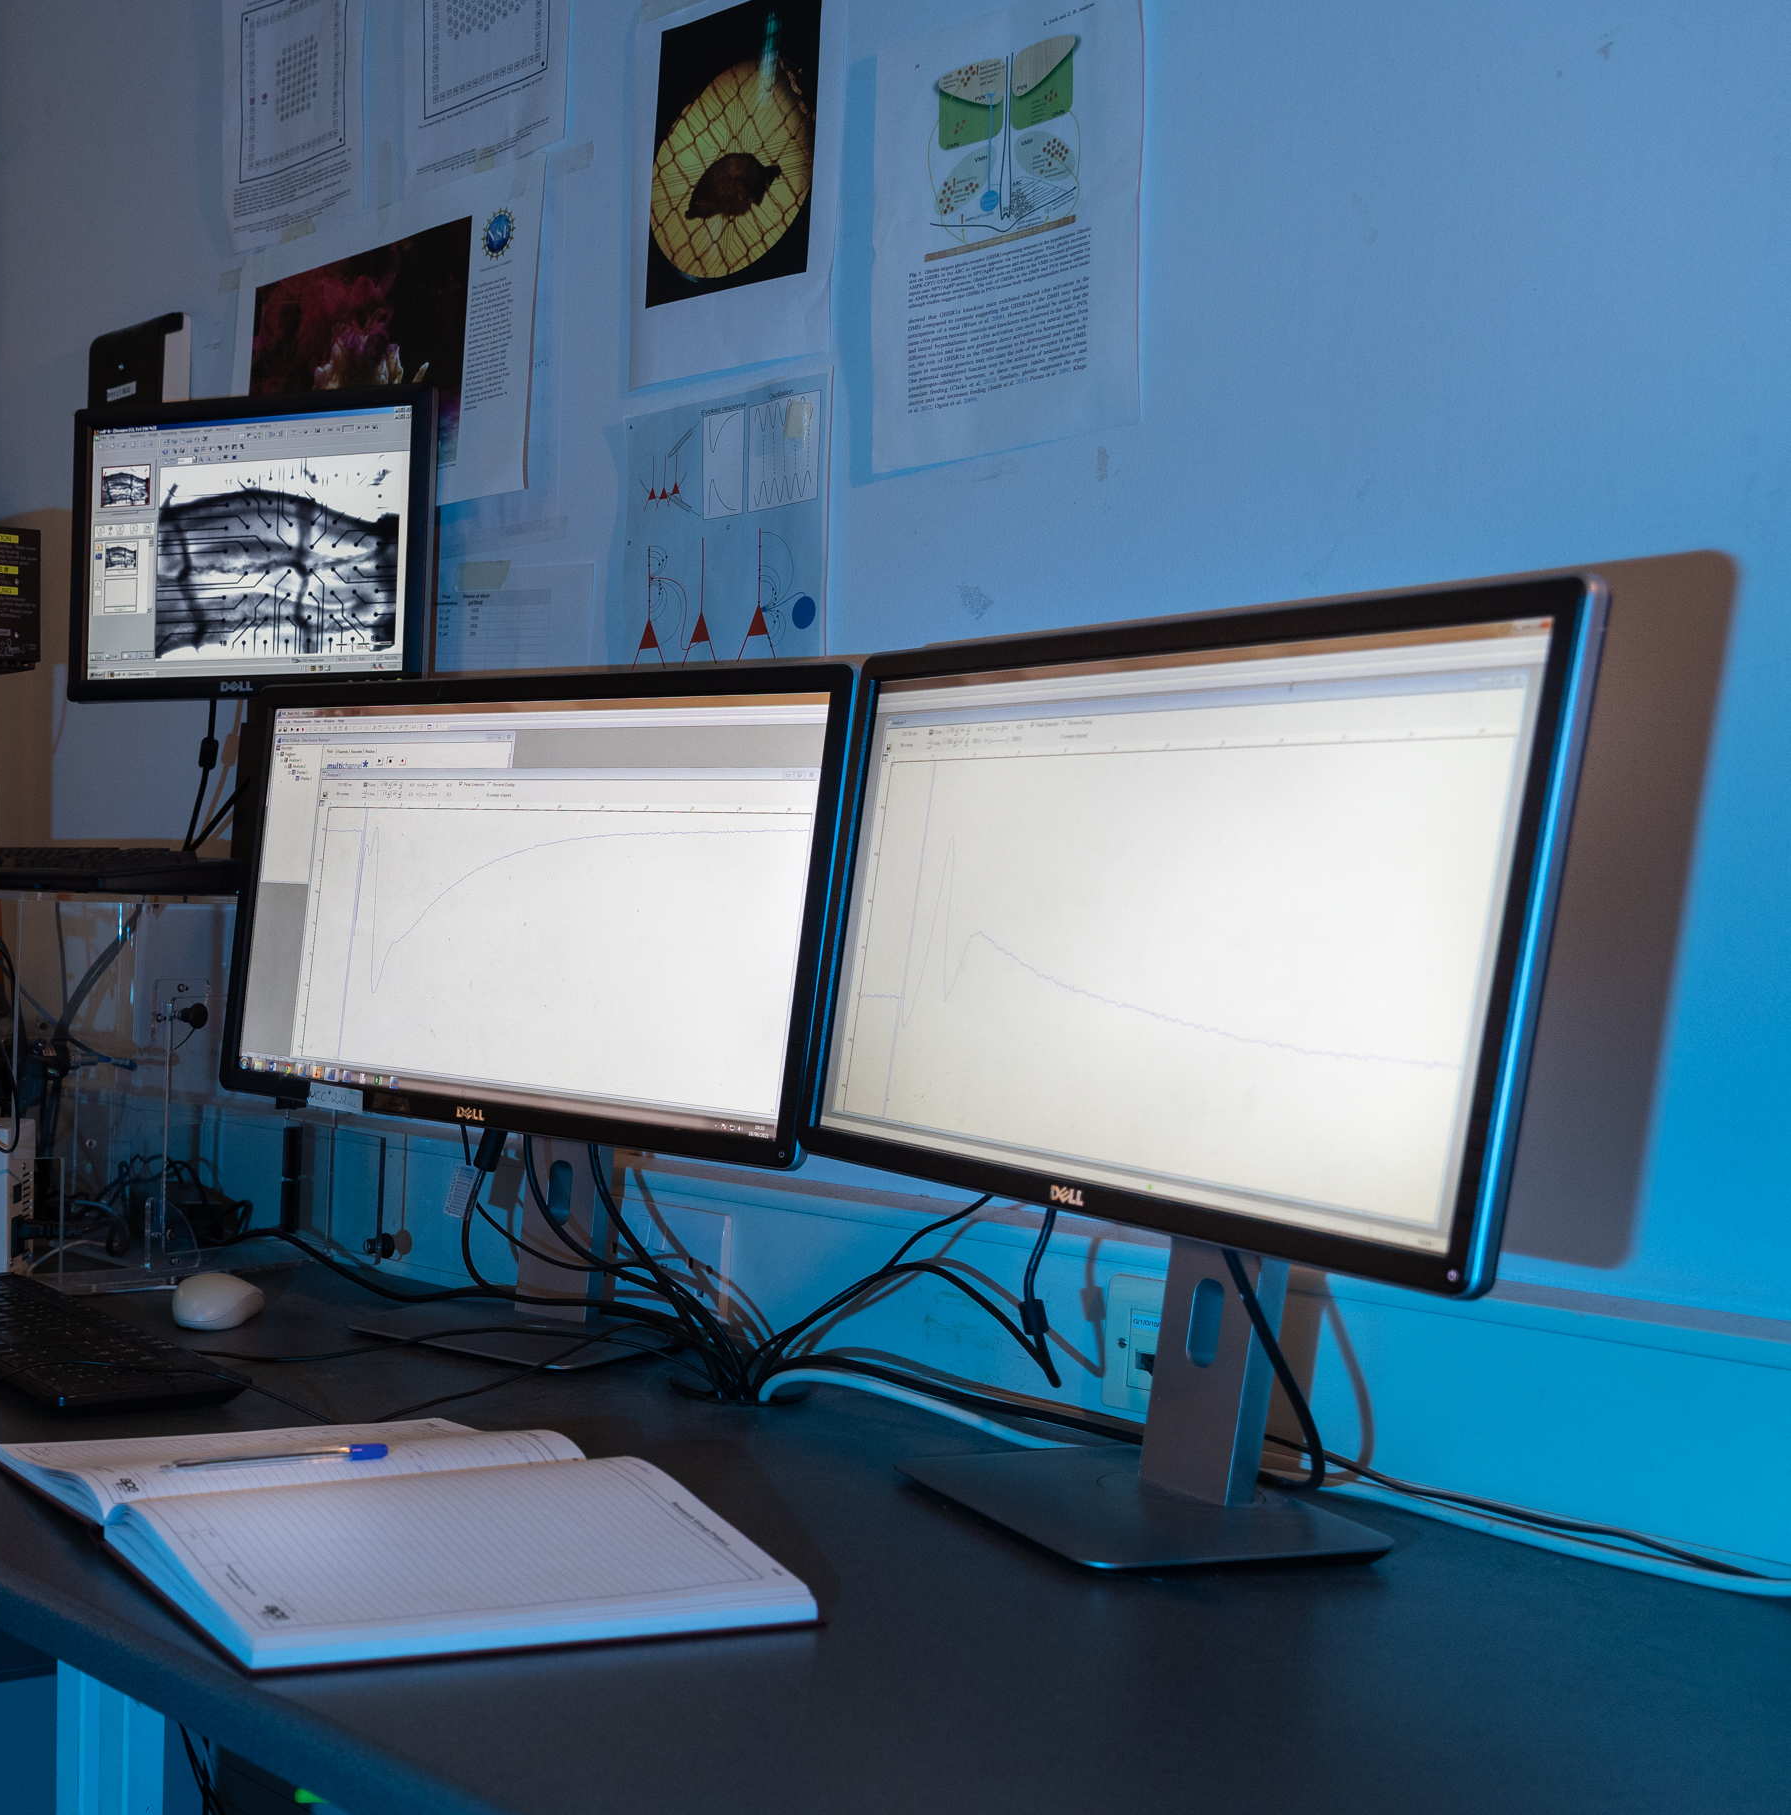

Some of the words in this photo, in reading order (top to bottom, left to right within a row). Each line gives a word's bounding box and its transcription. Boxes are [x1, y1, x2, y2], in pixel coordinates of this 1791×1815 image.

[1016, 83, 1028, 92] PVN
[974, 94, 986, 102] PVN
[946, 142, 960, 150] DMN
[1021, 138, 1033, 147] VMH
[974, 154, 988, 163] VMH
[1012, 179, 1022, 188] ARC
[486, 221, 511, 245] NSF
[907, 316, 926, 324] showed
[962, 303, 984, 313] knockout
[998, 294, 1020, 304] exhibited
[1022, 289, 1040, 299] reduced
[1053, 280, 1074, 291] activation
[922, 320, 946, 330] compared
[955, 314, 974, 322] controls
[975, 308, 999, 319] suggesting
[1047, 292, 1060, 300] DMH
[1061, 289, 1071, 297] may
[1072, 283, 1089, 293] mediate
[907, 330, 935, 341] anticipation
[1007, 308, 1029, 319] However,
[1035, 302, 1050, 311] should
[1058, 296, 1071, 305] noted
[931, 334, 948, 343] pattern
[949, 330, 968, 339] between
[969, 326, 987, 334] controls
[997, 318, 1020, 328] knockouts
[1030, 310, 1049, 320] observed
[768, 389, 793, 400] Oscillation
[701, 408, 721, 416] Evoked
[722, 402, 747, 412] response
[219, 680, 253, 692] DELL
[327, 761, 362, 769] multichannel
[456, 1106, 485, 1121] DELL
[1050, 1184, 1084, 1206] DELL
